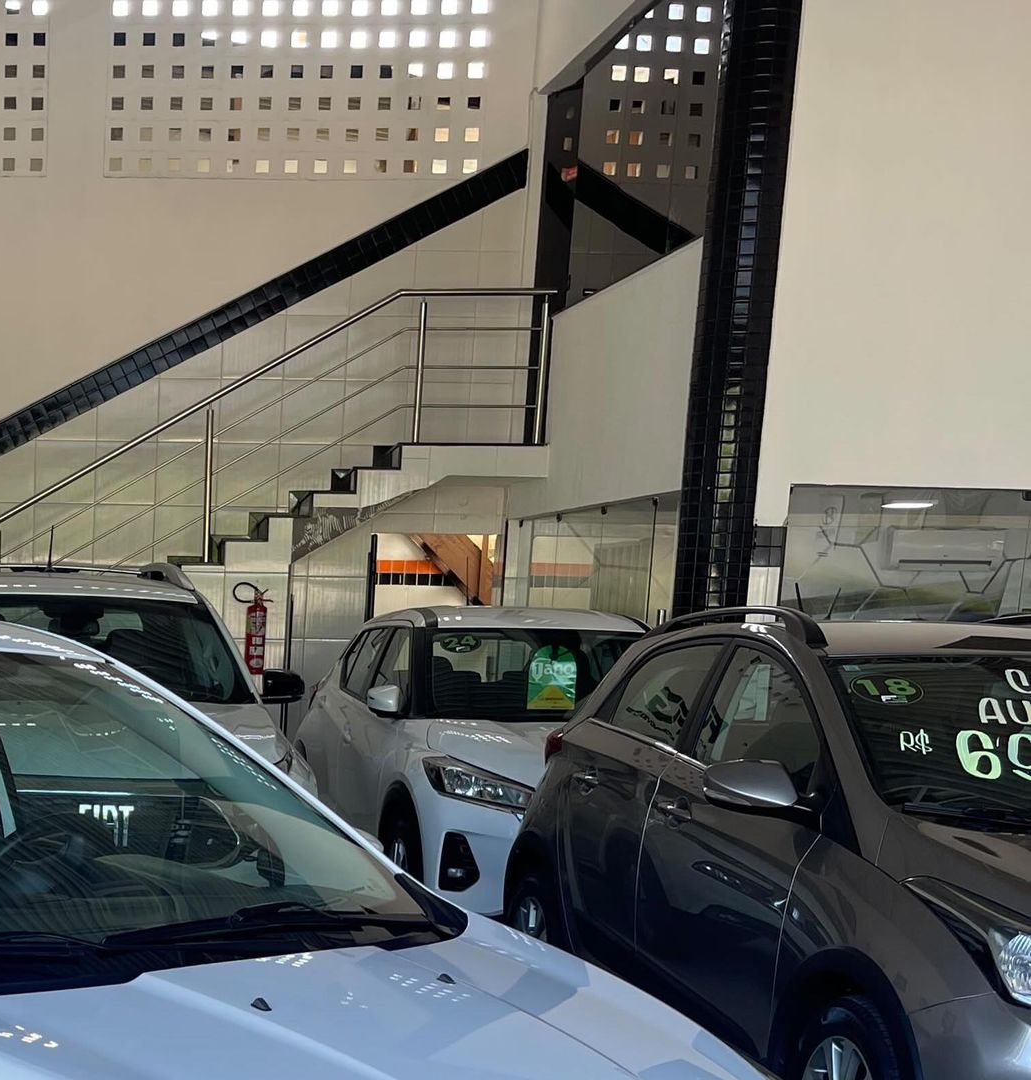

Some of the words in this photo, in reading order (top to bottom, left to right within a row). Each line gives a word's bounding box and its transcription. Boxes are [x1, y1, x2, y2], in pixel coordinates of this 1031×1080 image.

[856, 679, 916, 696] 18
[978, 697, 1031, 725] AU
[900, 729, 933, 755] R$
